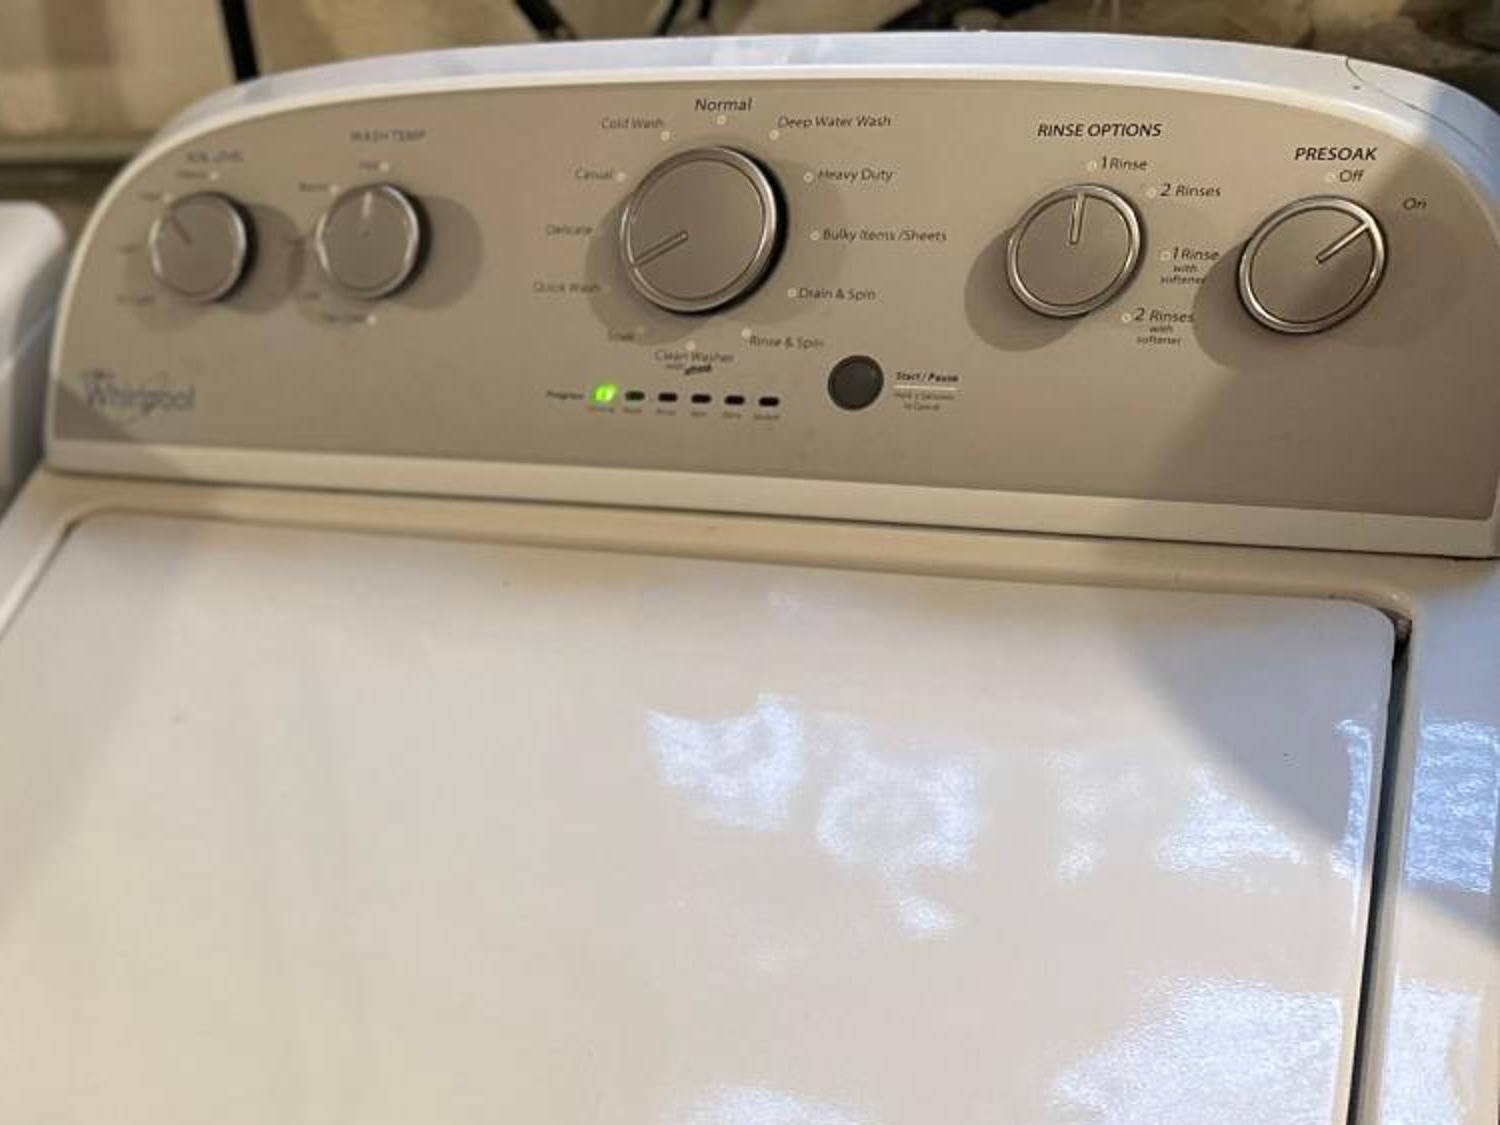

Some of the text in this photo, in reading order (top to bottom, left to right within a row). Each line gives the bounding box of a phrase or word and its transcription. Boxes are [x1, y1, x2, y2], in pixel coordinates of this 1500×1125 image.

[693, 97, 753, 112] Normal
[601, 116, 665, 129] Cold Wash
[777, 115, 892, 129] Deep Water Wash
[1037, 122, 1164, 137] RINSE OPTIONS
[1294, 147, 1378, 161] PRESOAK
[1109, 157, 1148, 171] Rinse
[574, 167, 614, 180] Casual
[817, 168, 894, 184] Heavy Duty
[1339, 169, 1365, 183] Off
[1160, 183, 1222, 198] 2 Rinses
[1402, 197, 1428, 211] On
[545, 223, 593, 236] Delicate
[822, 228, 857, 244] Bulky
[859, 228, 896, 242] Items
[1181, 247, 1220, 261] Rinse
[798, 287, 877, 302] Drain & Spin
[1134, 307, 1195, 323] 2 Rinses
[749, 335, 782, 348] Rinse
[654, 350, 734, 363] Clean Washer
